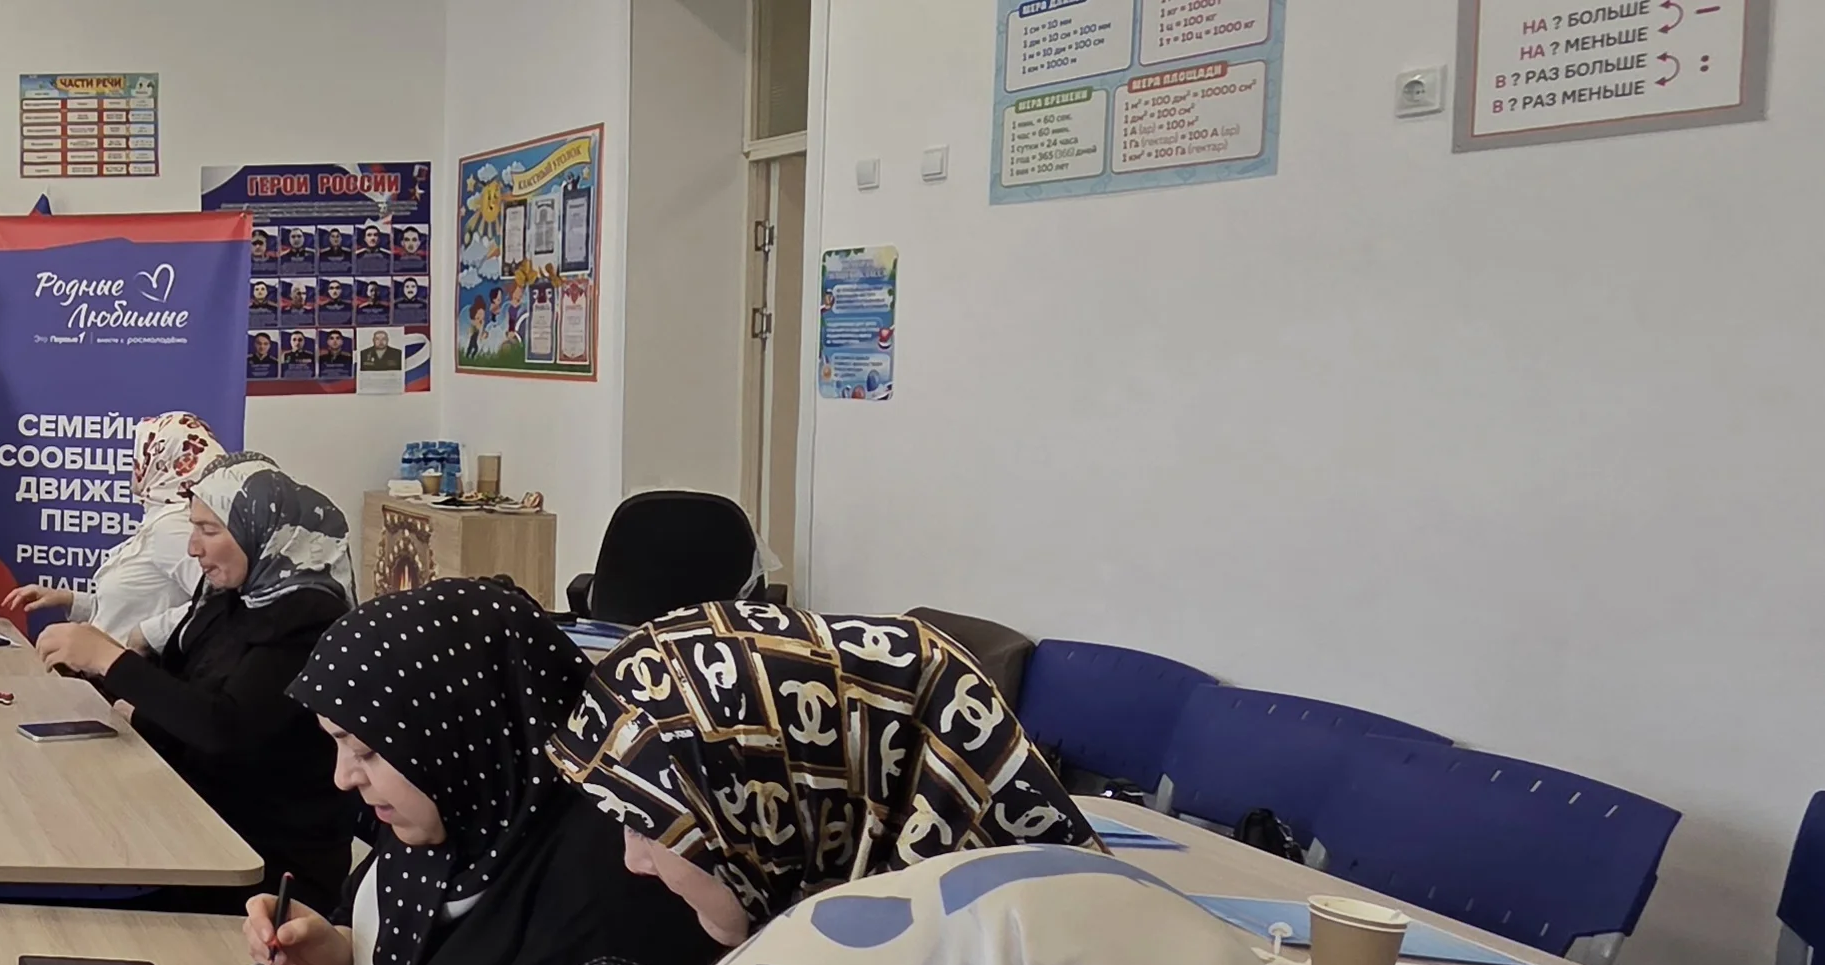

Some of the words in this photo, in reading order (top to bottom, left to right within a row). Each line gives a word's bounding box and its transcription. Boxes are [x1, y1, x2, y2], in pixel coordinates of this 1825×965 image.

[1523, 18, 1547, 34] НА
[1553, 16, 1562, 29] ?
[1568, 0, 1651, 27] БОЛЬШЕ
[1520, 44, 1545, 60] НА
[1550, 41, 1560, 55] ?
[1565, 27, 1648, 53] МЕНЬШЕ
[60, 78, 93, 88] ЧАСТИ
[96, 78, 121, 88] РЕЧИ
[1132, 76, 1160, 90] МЕРА
[1163, 64, 1221, 84] ПЛОЩАДИ
[1495, 75, 1506, 88] В
[1511, 73, 1520, 86] ?
[1525, 67, 1559, 84] РАЗ
[1565, 53, 1647, 79] БОЛЬШЕ
[1493, 100, 1503, 113] В
[1508, 98, 1517, 111] ?
[1523, 93, 1557, 109] РАЗ
[1562, 80, 1645, 104] МЕНЬШЕ
[247, 174, 310, 195] ГЕРОИ
[318, 173, 401, 194] РОССИИ
[35, 272, 124, 306] Родные
[68, 300, 189, 328] Любимые
[15, 476, 141, 504] ДВИЖЕ
